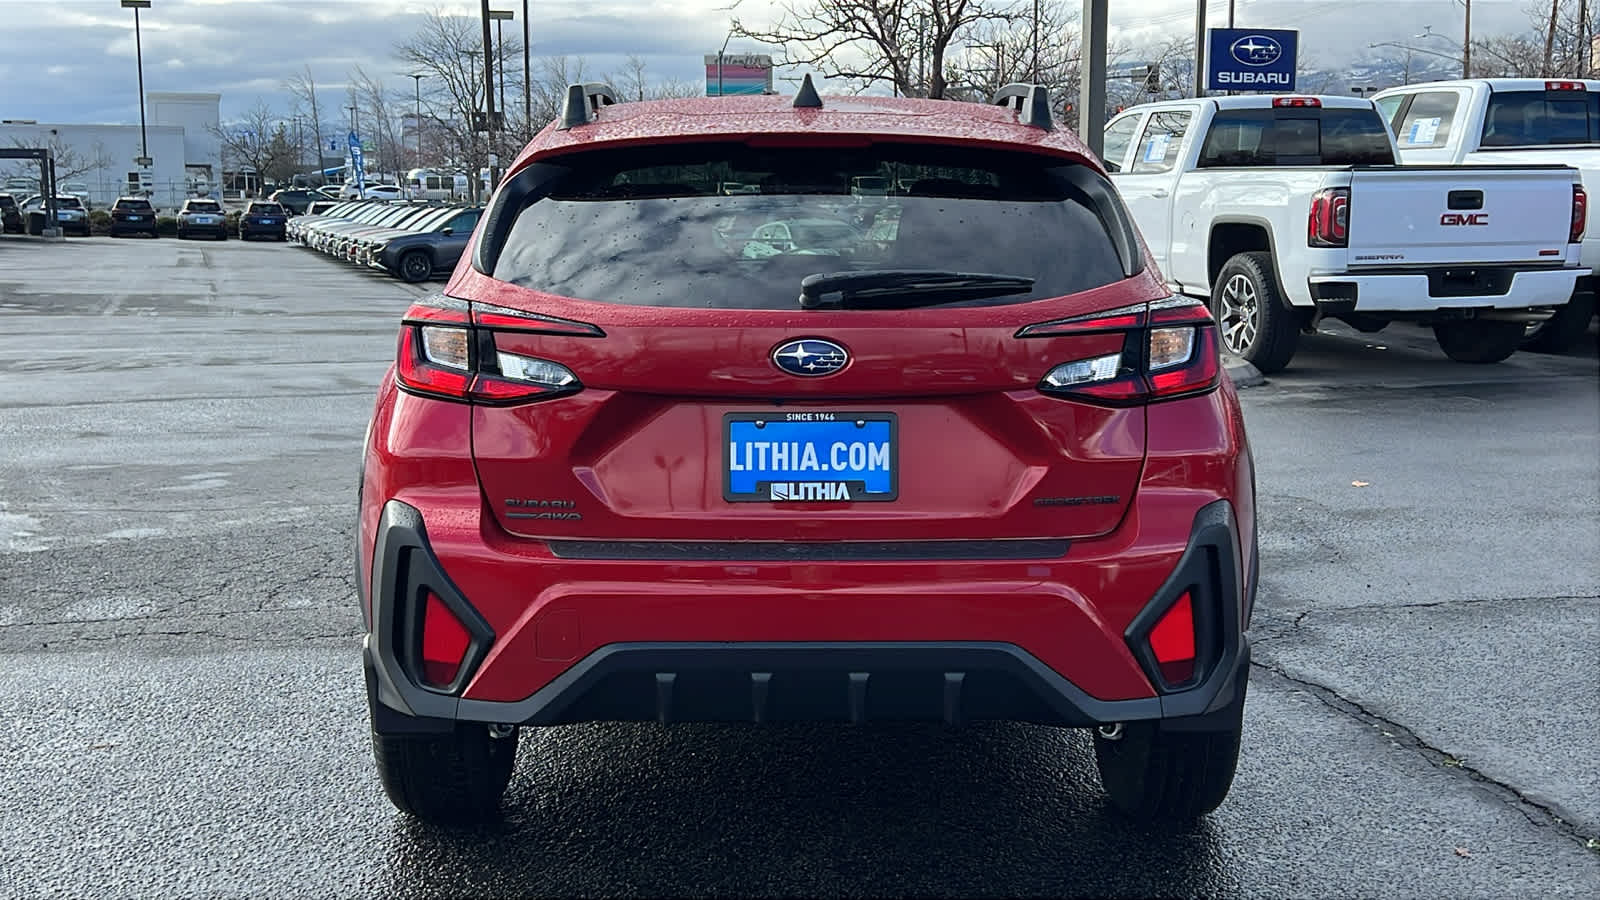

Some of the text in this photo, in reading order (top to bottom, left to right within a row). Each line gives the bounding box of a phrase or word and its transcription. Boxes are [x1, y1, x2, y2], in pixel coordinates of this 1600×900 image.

[1217, 71, 1290, 84] SUBARU
[1440, 213, 1489, 226] GMC
[786, 413, 835, 422] SINCE 1946
[729, 441, 890, 472] LITHIA.COM
[787, 482, 851, 501] LITHIA
[504, 498, 576, 509] SUBARU
